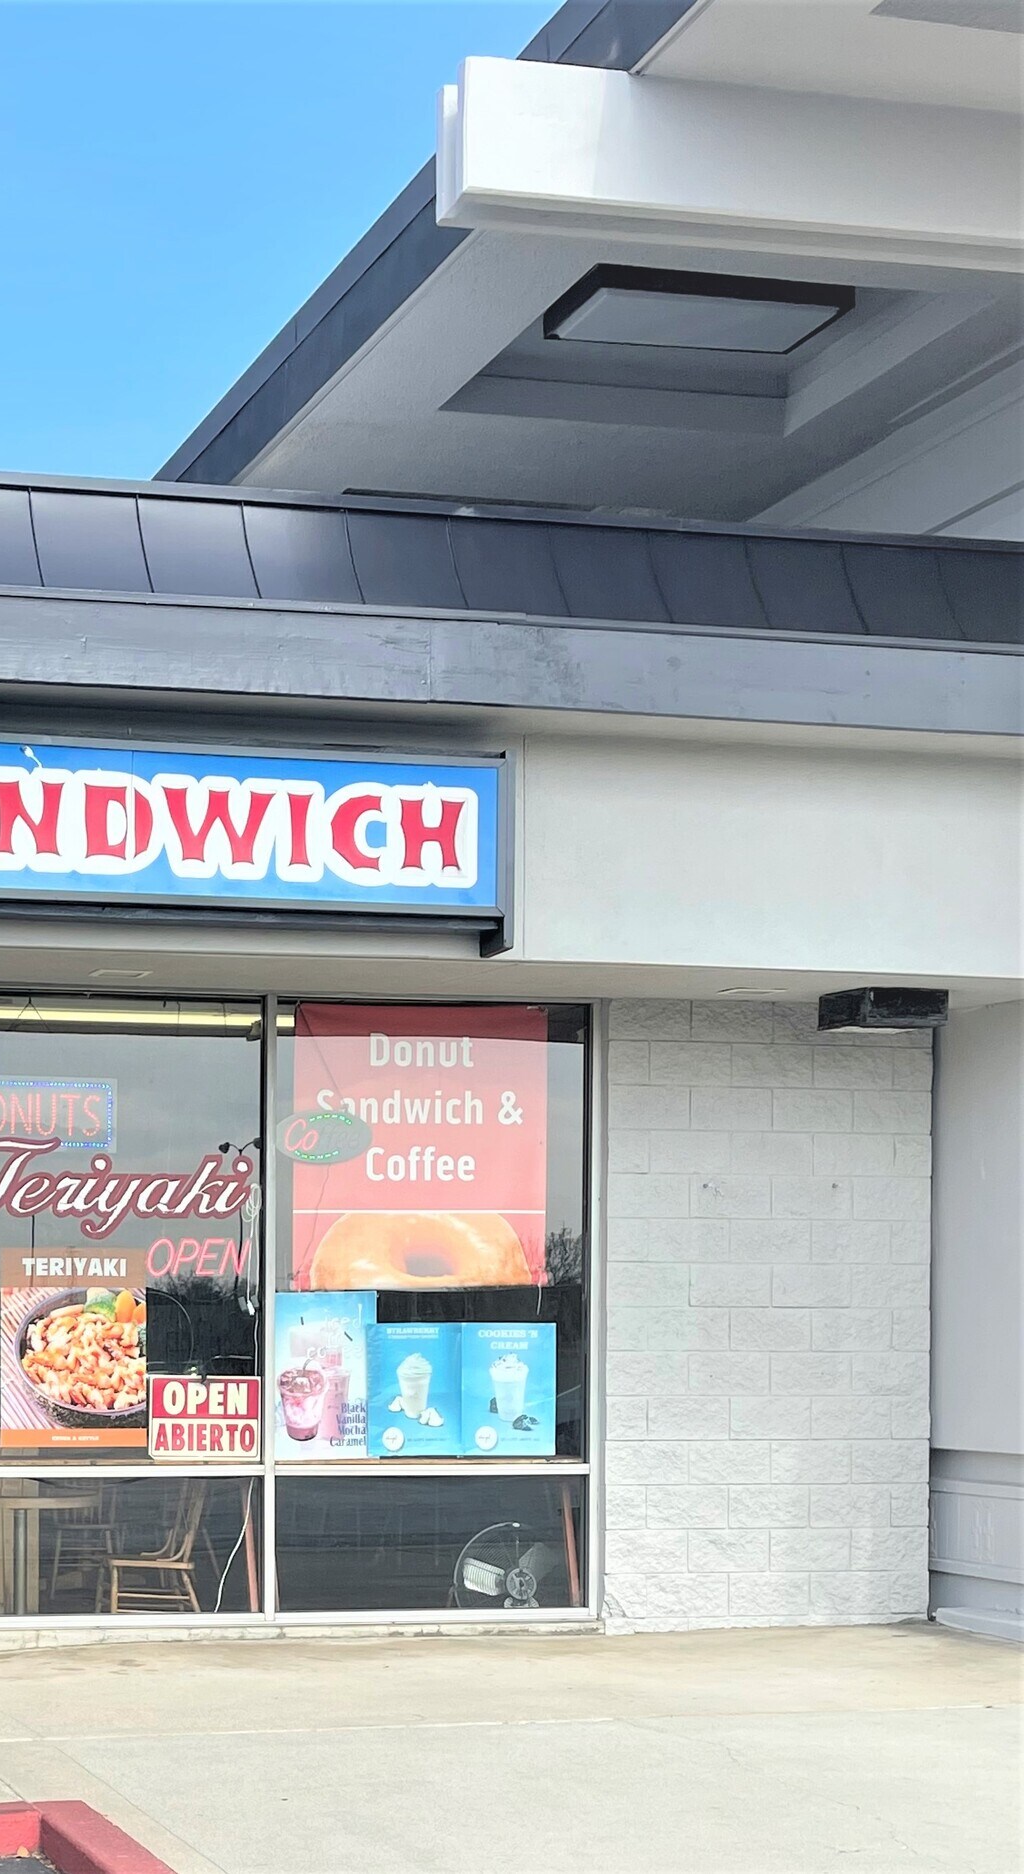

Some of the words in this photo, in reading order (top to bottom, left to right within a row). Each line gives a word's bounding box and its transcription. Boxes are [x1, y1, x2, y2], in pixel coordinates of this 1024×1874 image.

[369, 1033, 474, 1068] Donut
[316, 1089, 483, 1124] Sandwich
[497, 1091, 524, 1125] &
[366, 1146, 476, 1181] Coffee
[22, 1257, 127, 1278] TERIYAKI
[145, 1237, 251, 1278] OPEN
[478, 1329, 524, 1339] COOKIES
[490, 1341, 529, 1350] CREAM
[163, 1381, 248, 1416] OPEN
[341, 1402, 366, 1415] Black
[336, 1414, 366, 1424] Vanilla
[154, 1423, 256, 1452] ABIERTO
[329, 1435, 366, 1447] Caramel
[338, 1425, 366, 1436] Mocha
